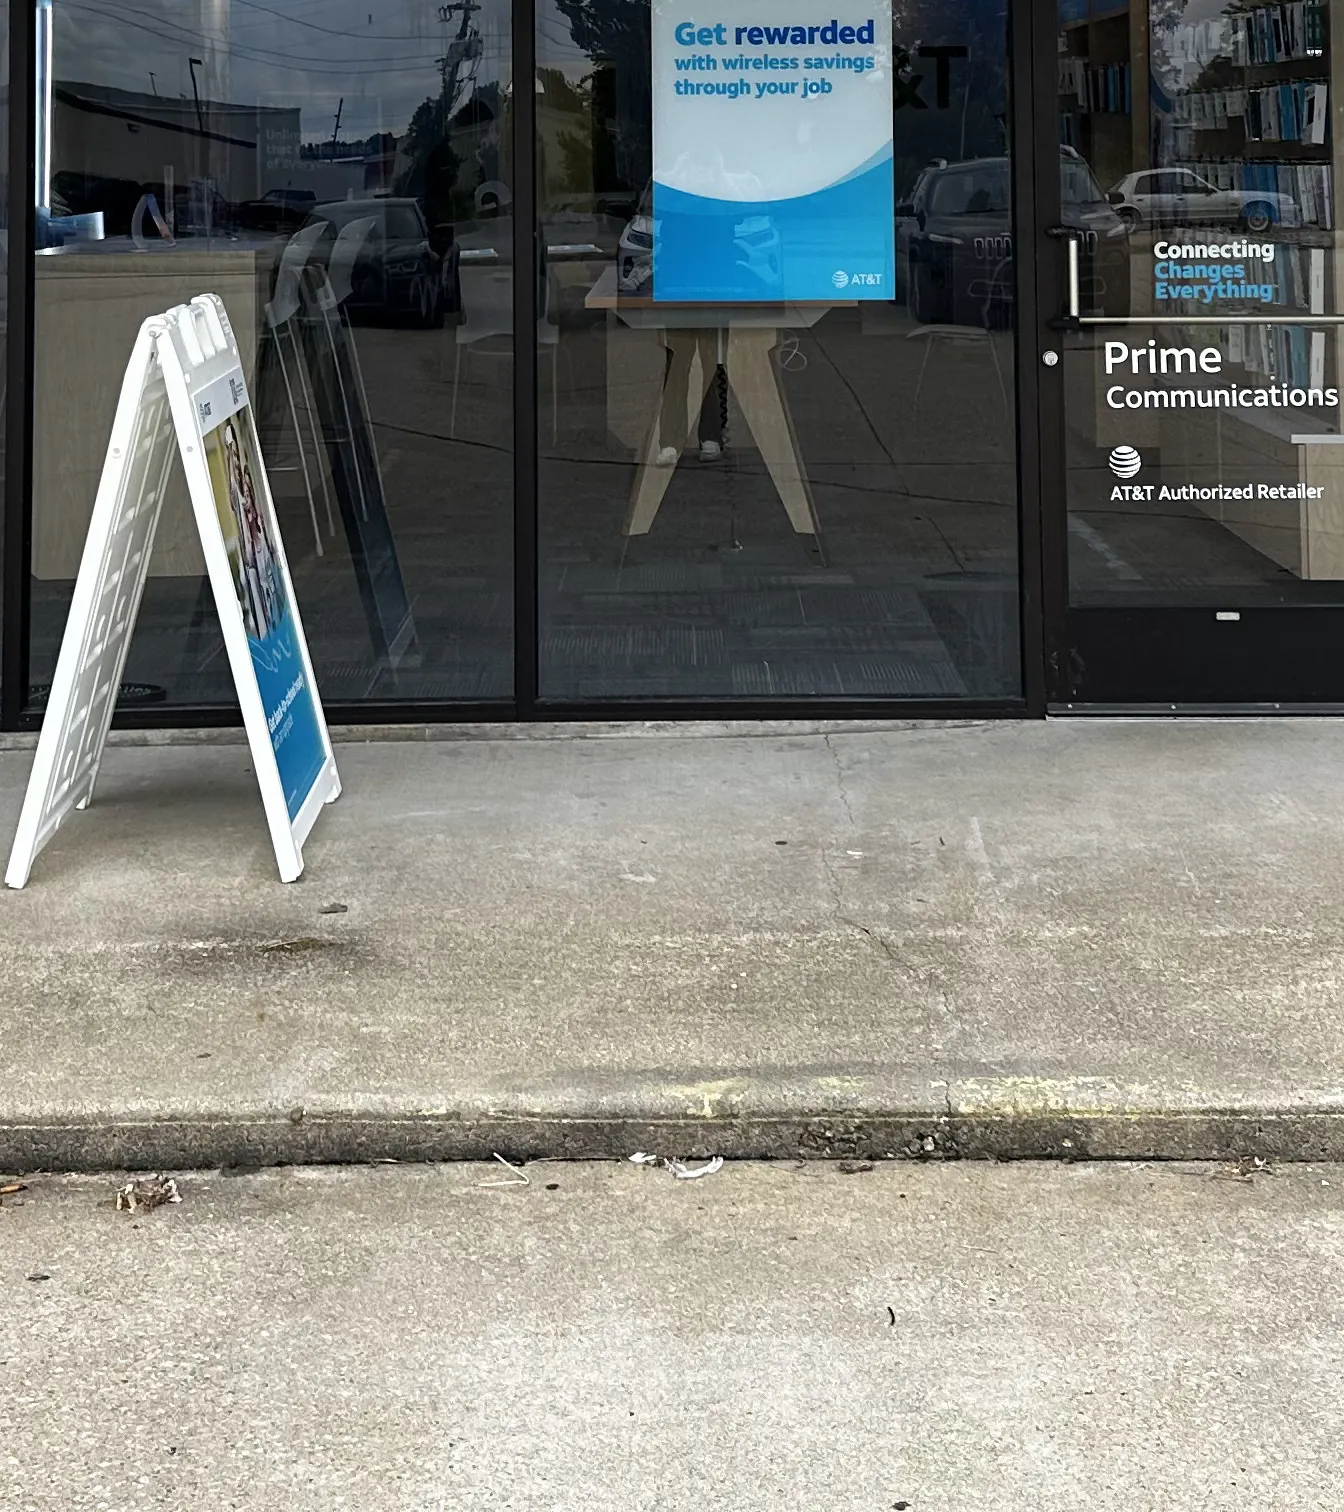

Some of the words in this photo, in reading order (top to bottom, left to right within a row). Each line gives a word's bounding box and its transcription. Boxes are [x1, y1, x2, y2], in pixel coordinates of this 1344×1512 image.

[674, 22, 727, 46] Get
[734, 19, 875, 45] rewarded
[674, 54, 718, 71] with
[722, 53, 799, 71] wireless
[803, 52, 875, 73] savings
[674, 78, 751, 99] through
[755, 81, 798, 99] your
[801, 77, 833, 99] job
[1154, 239, 1275, 263] Connecting
[851, 273, 883, 286] AT&T
[1154, 261, 1245, 283] Changes
[1154, 281, 1274, 304] Everything
[1104, 339, 1222, 375] Prime
[1106, 383, 1339, 409] Communications
[1110, 485, 1155, 501] AT&T
[1158, 483, 1254, 501] Authorized
[1256, 483, 1325, 501] Retailer
